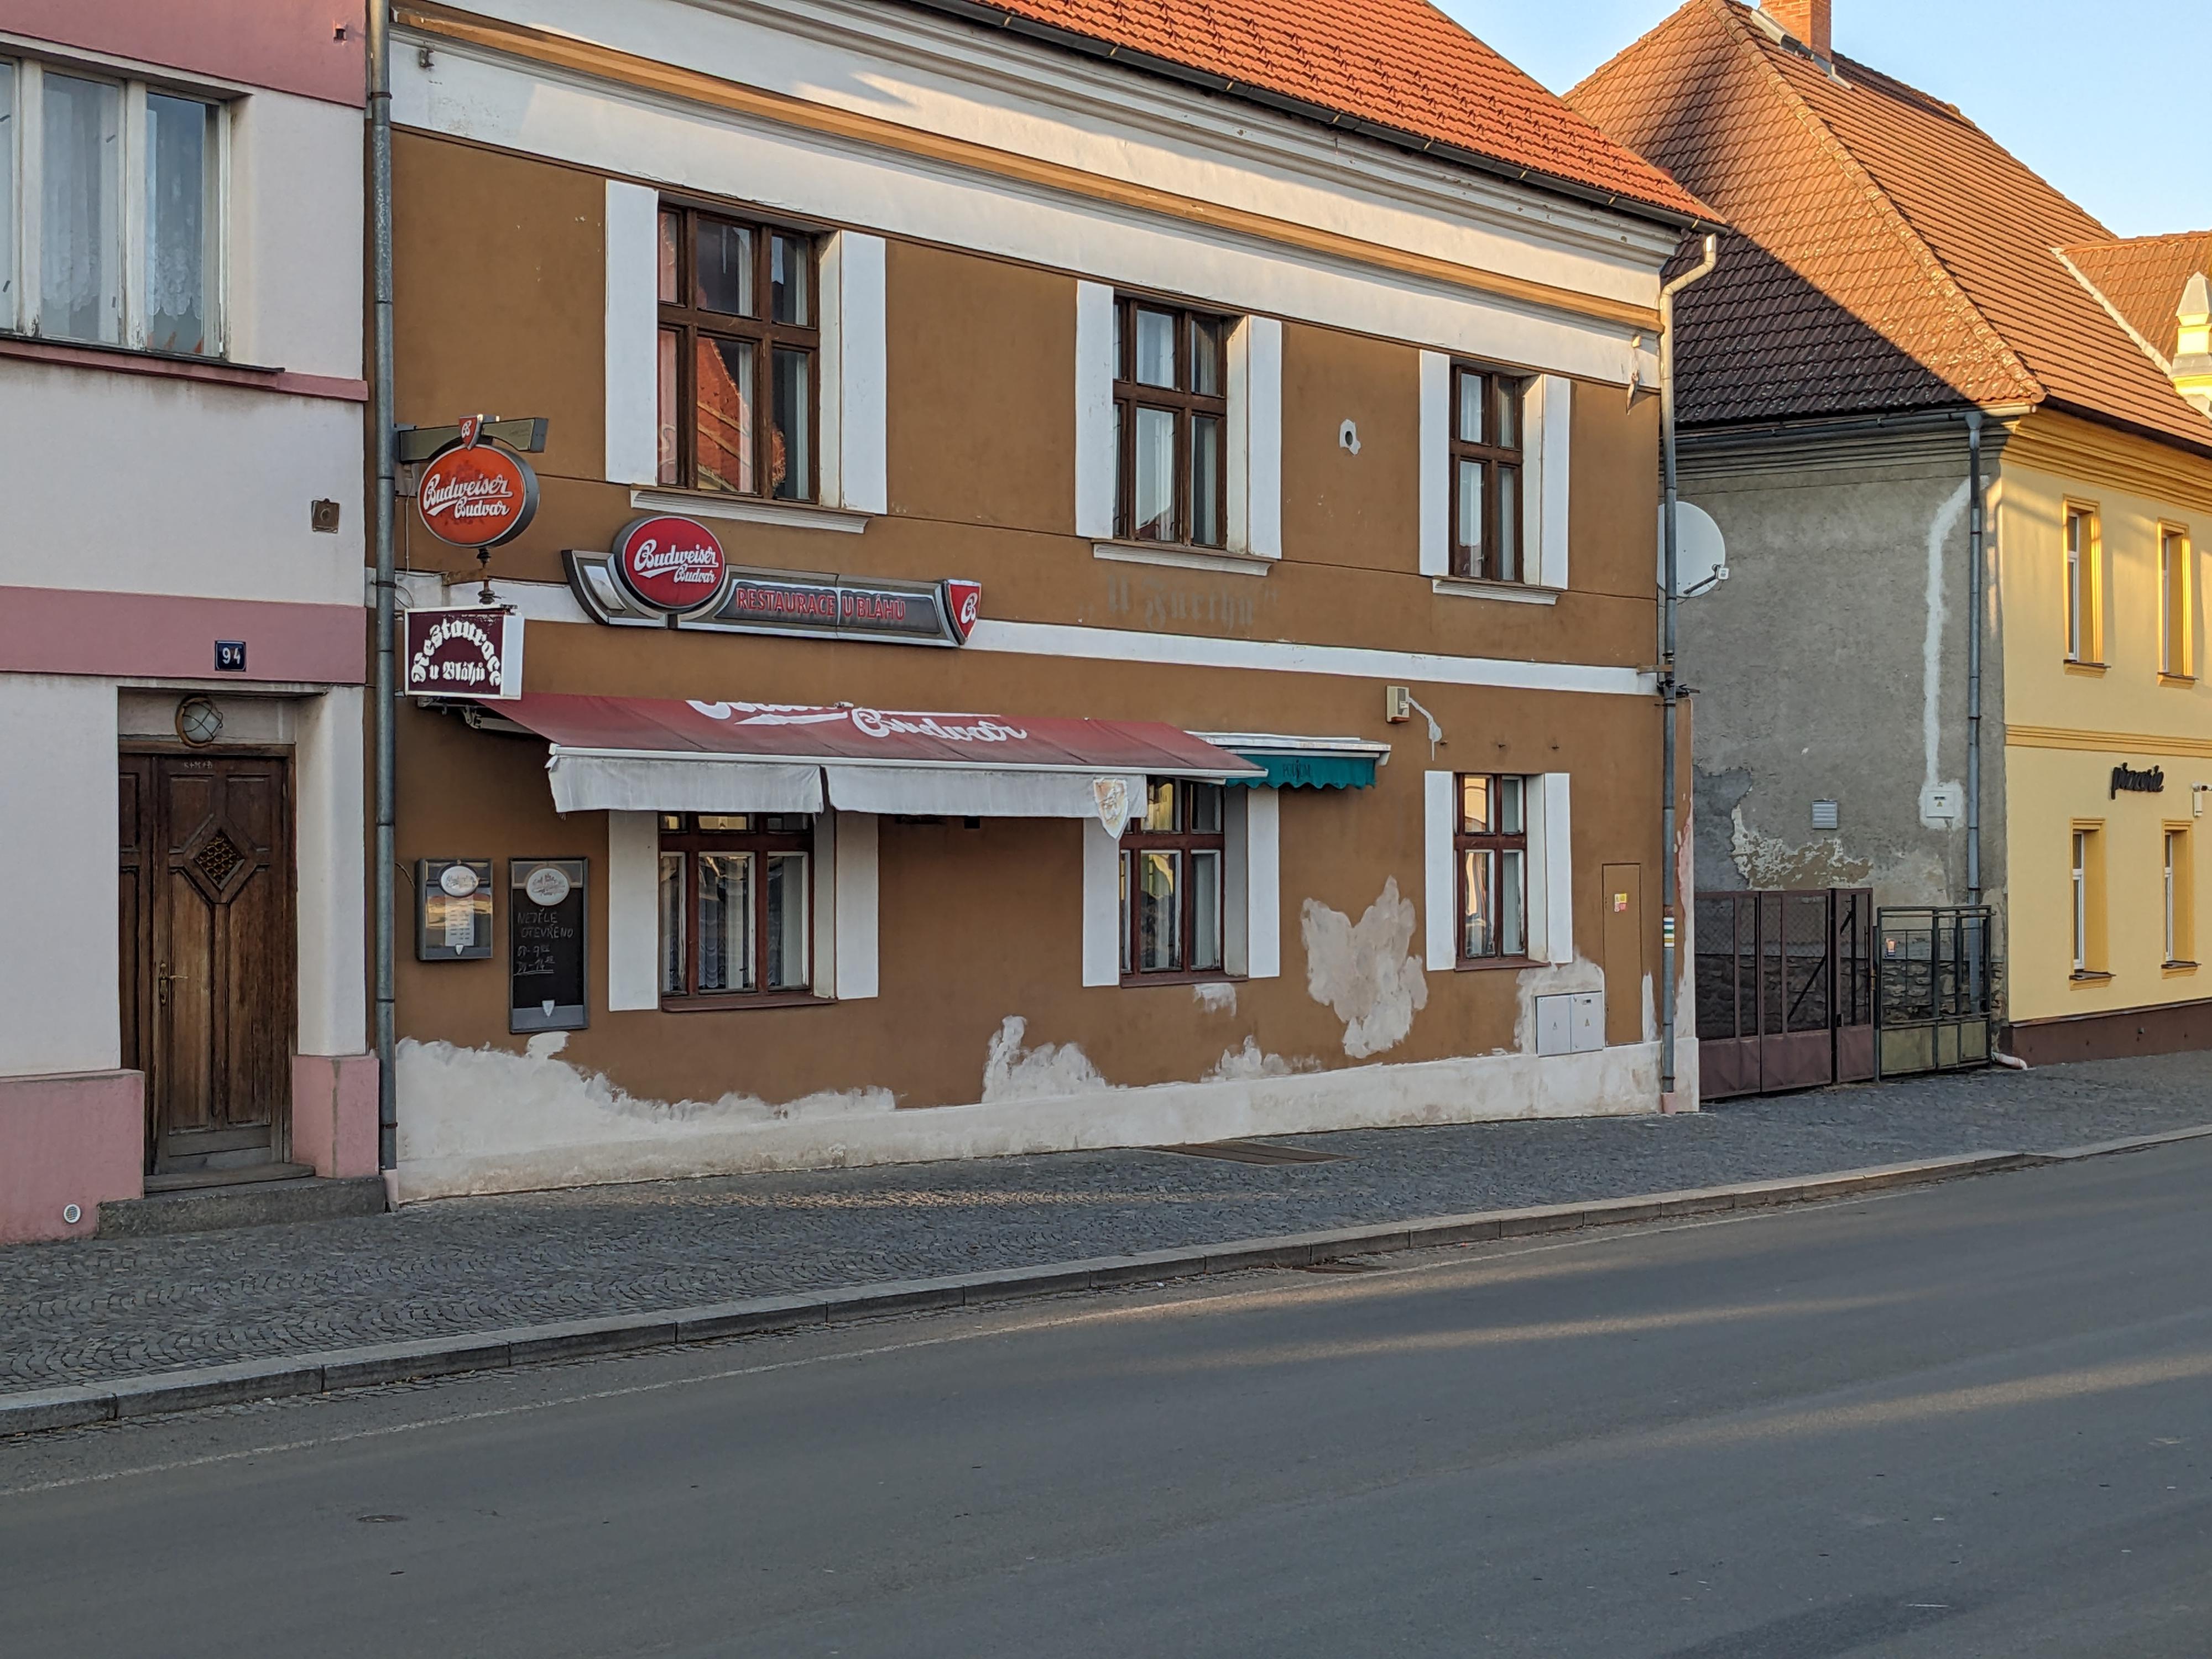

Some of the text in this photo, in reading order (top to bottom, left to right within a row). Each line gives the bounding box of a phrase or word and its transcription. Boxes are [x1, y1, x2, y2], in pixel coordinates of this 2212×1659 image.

[423, 473, 513, 510] Budweiser
[454, 496, 510, 519] Budvar
[634, 539, 719, 571] Budweiser
[674, 564, 716, 583] Budvar
[735, 588, 905, 620] RESTAURACE U BLÁHŮ
[222, 647, 241, 665] 94
[411, 618, 502, 686] Restaurace
[517, 906, 558, 924] NEDĚLE
[521, 923, 574, 938] OTEVŘENO
